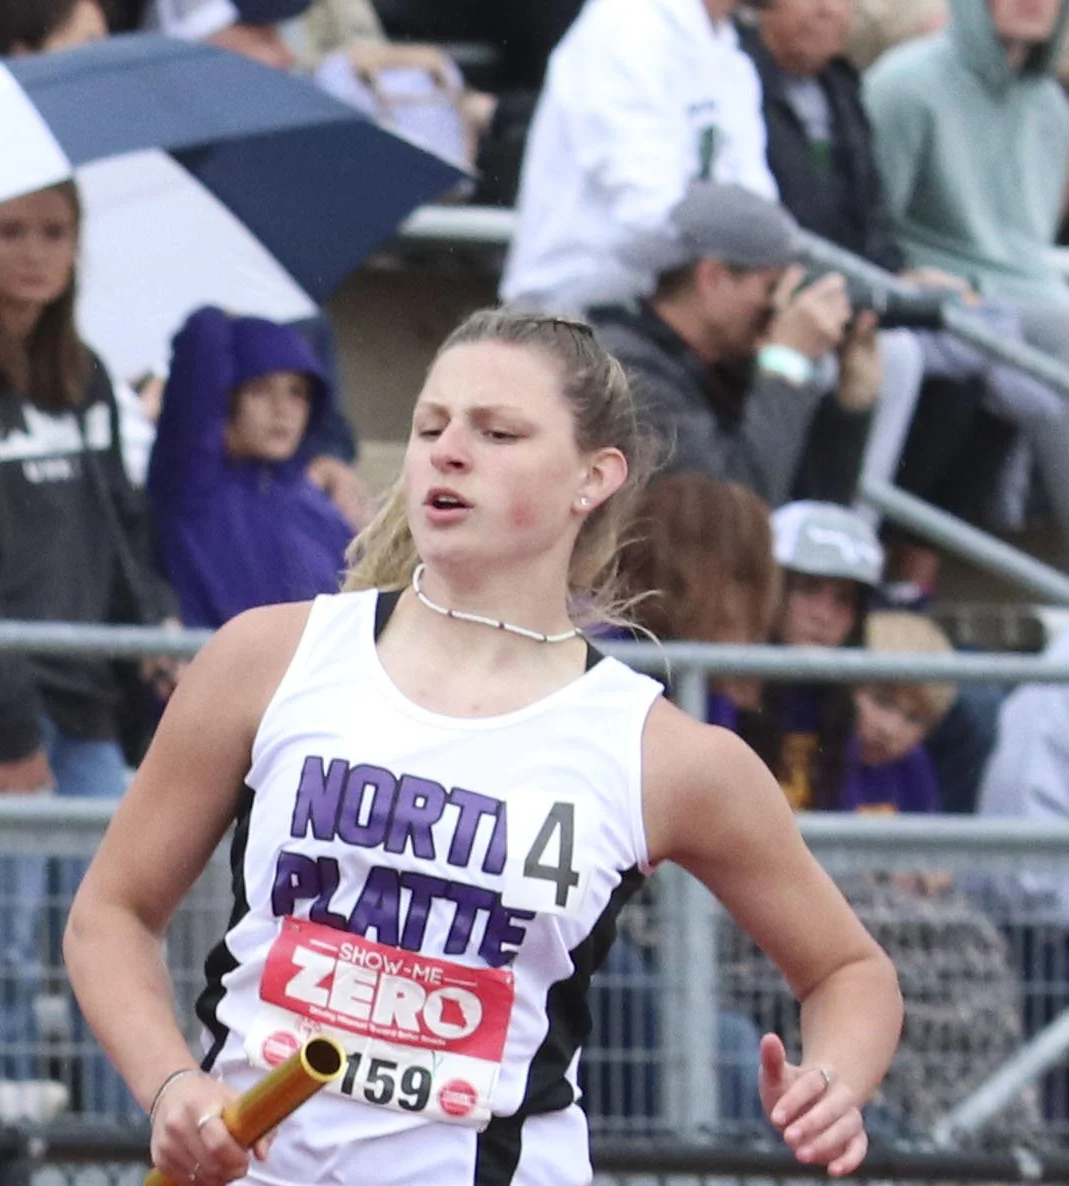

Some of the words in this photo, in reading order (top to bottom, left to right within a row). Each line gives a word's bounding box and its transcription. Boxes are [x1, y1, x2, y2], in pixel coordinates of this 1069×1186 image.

[523, 801, 580, 908] 4
[270, 850, 537, 967] PLATTE
[284, 946, 483, 1039] ZERO
[339, 942, 444, 984] SHOW-ME
